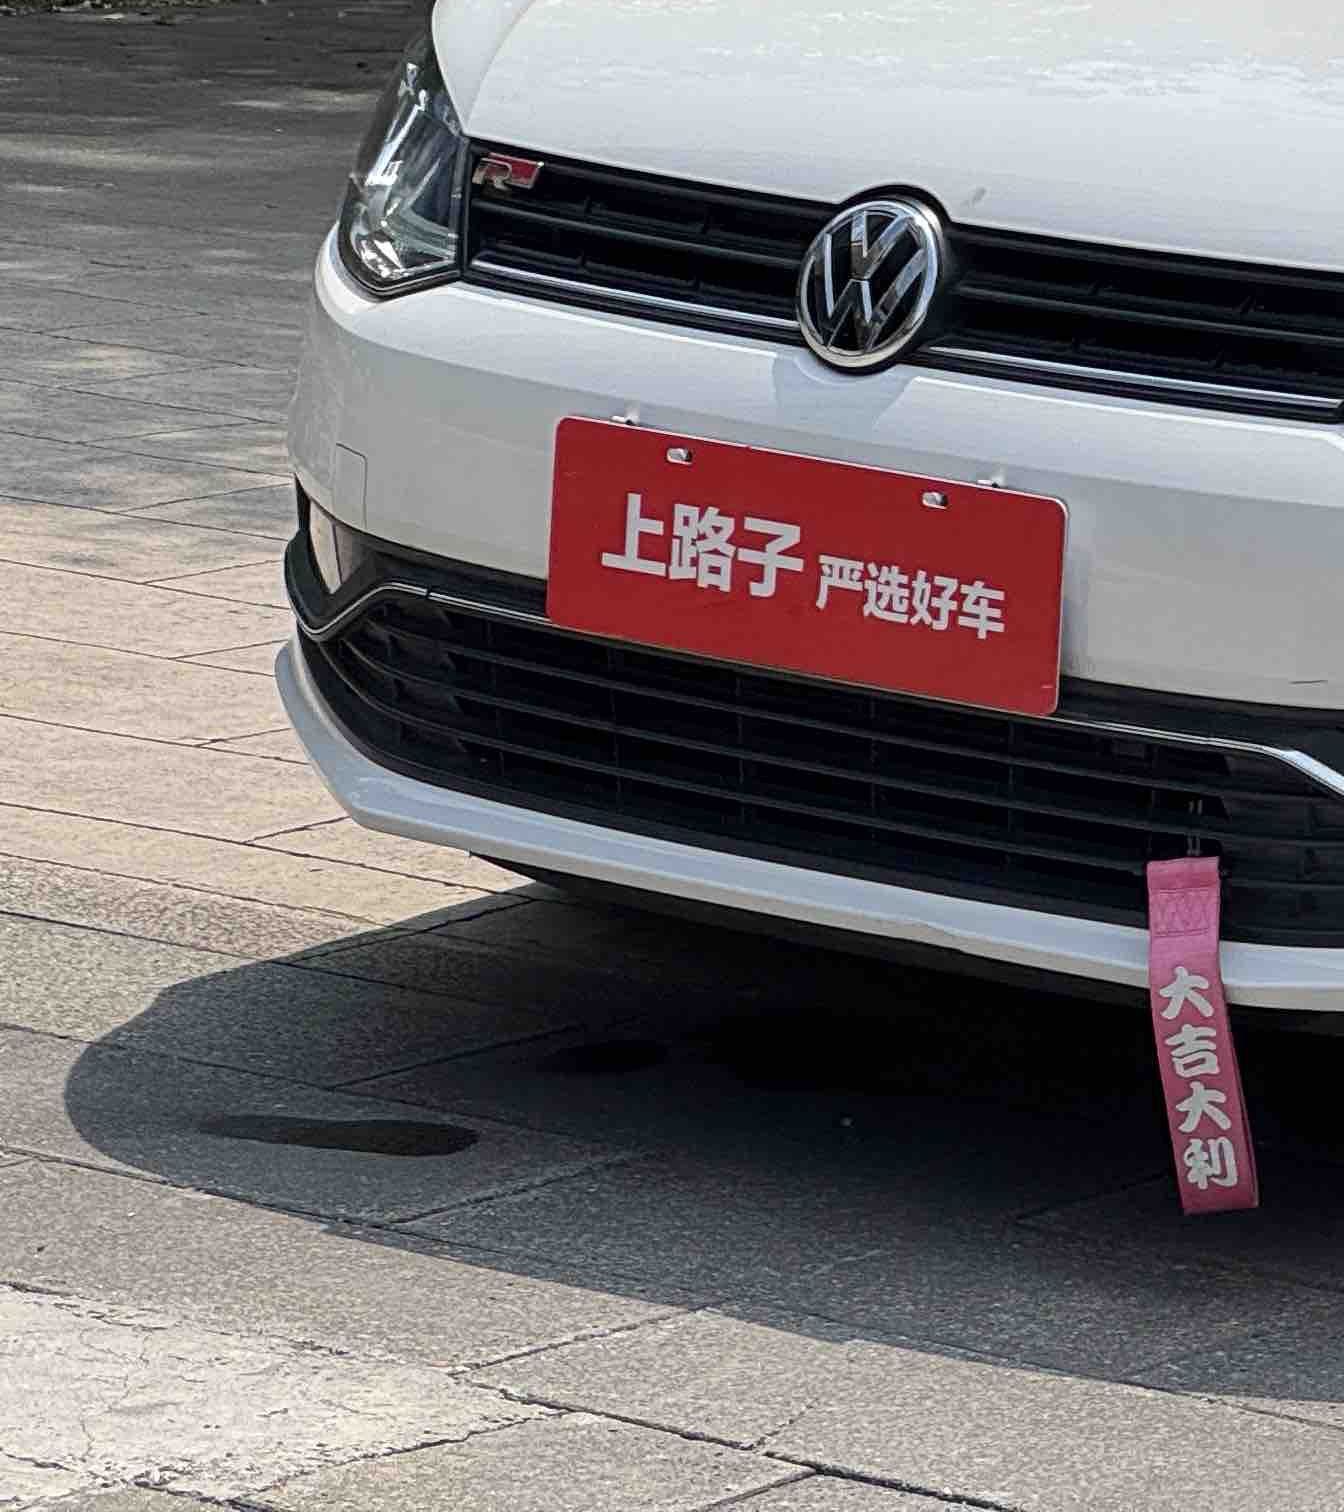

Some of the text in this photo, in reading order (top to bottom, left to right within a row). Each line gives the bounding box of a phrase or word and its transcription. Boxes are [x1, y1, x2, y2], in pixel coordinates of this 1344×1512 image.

[601, 493, 1005, 638] 上路子 严选好车
[1160, 966, 1239, 1190] 大吉大利
